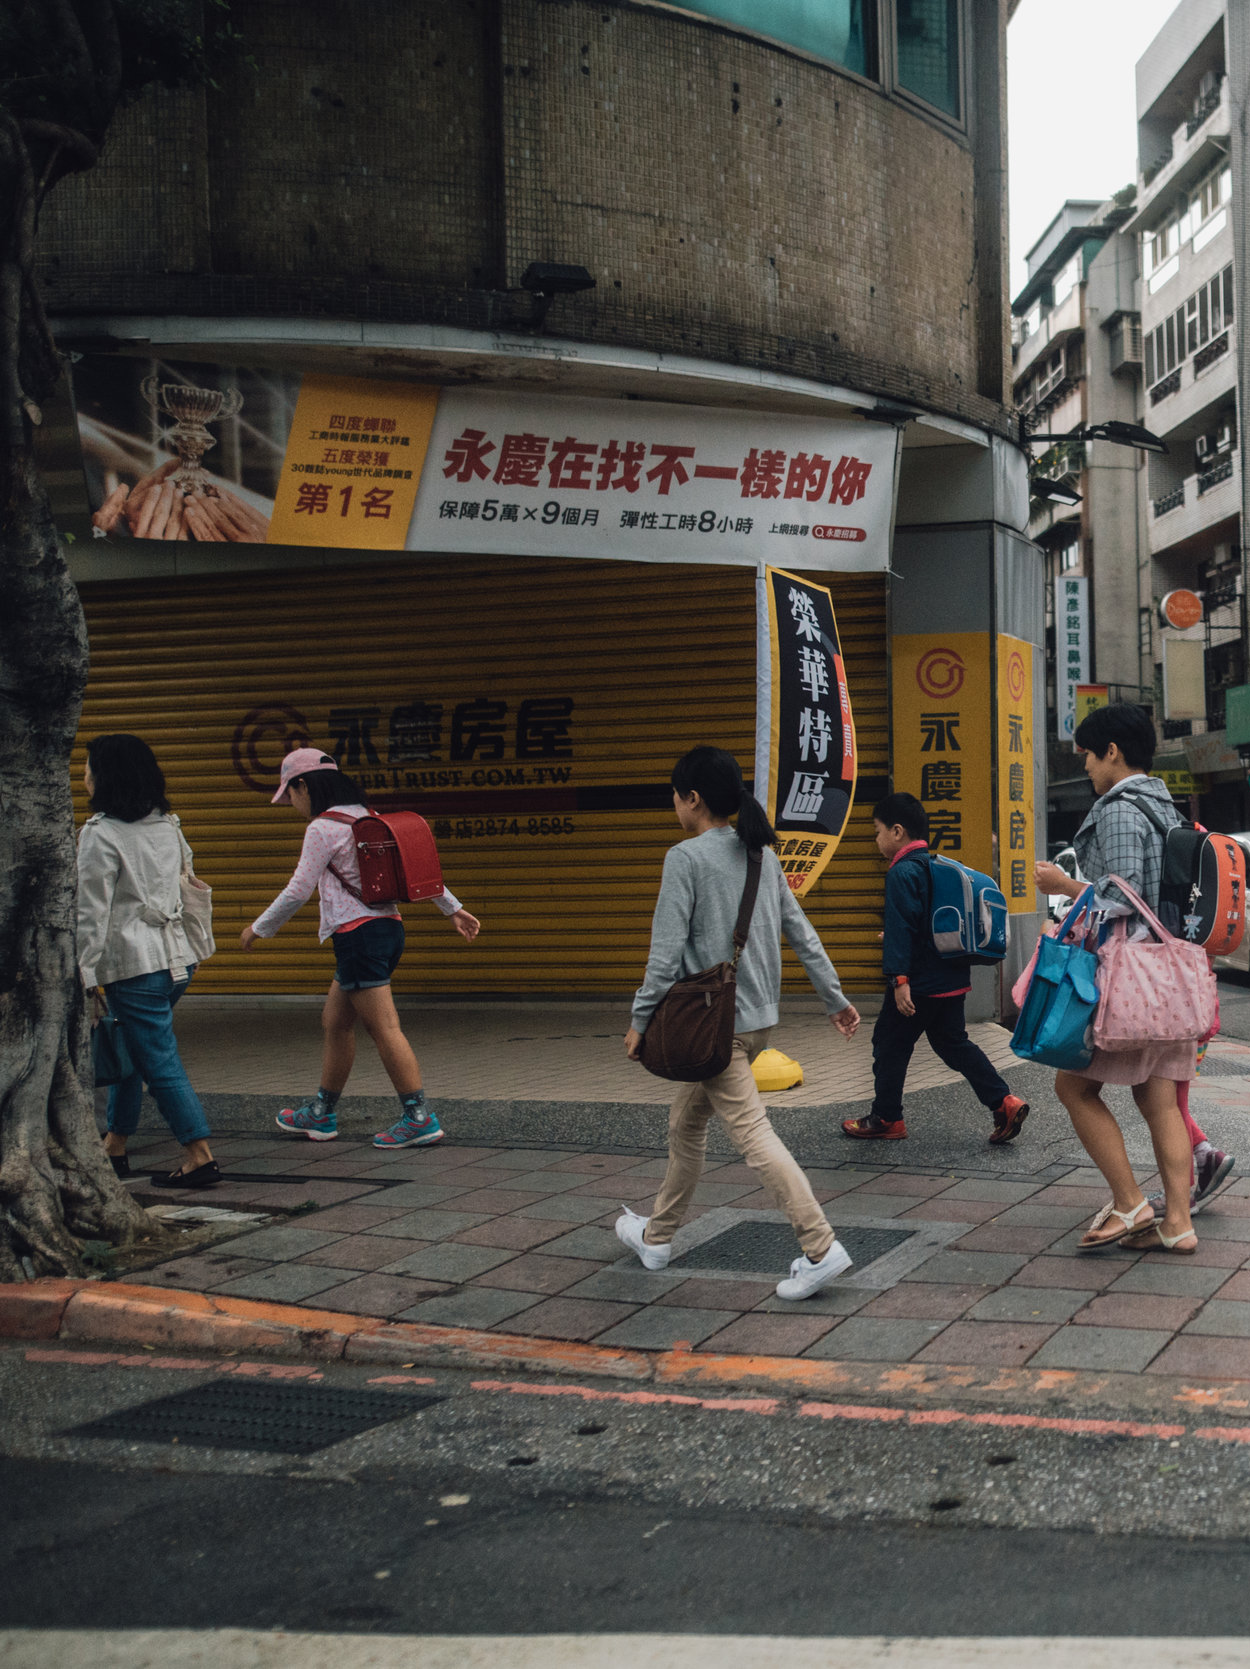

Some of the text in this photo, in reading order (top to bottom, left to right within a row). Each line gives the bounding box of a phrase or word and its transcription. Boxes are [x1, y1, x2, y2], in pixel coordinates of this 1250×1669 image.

[321, 448, 391, 467] 五度榮獲
[442, 428, 873, 506] 永慶在找不一樣的你
[294, 482, 394, 519] 第1名
[439, 499, 600, 527] 保障5萬×9個月
[619, 510, 753, 535] 彈性工時8小時
[768, 523, 809, 537] 上網搜尋
[782, 587, 833, 821] 榮華特區
[328, 698, 575, 766] 永慶房屋
[920, 712, 962, 851] 永慶房
[1008, 713, 1027, 898] 永慶房屋
[527, 816, 576, 837] 8585
[773, 838, 828, 857] 永慶房屋
